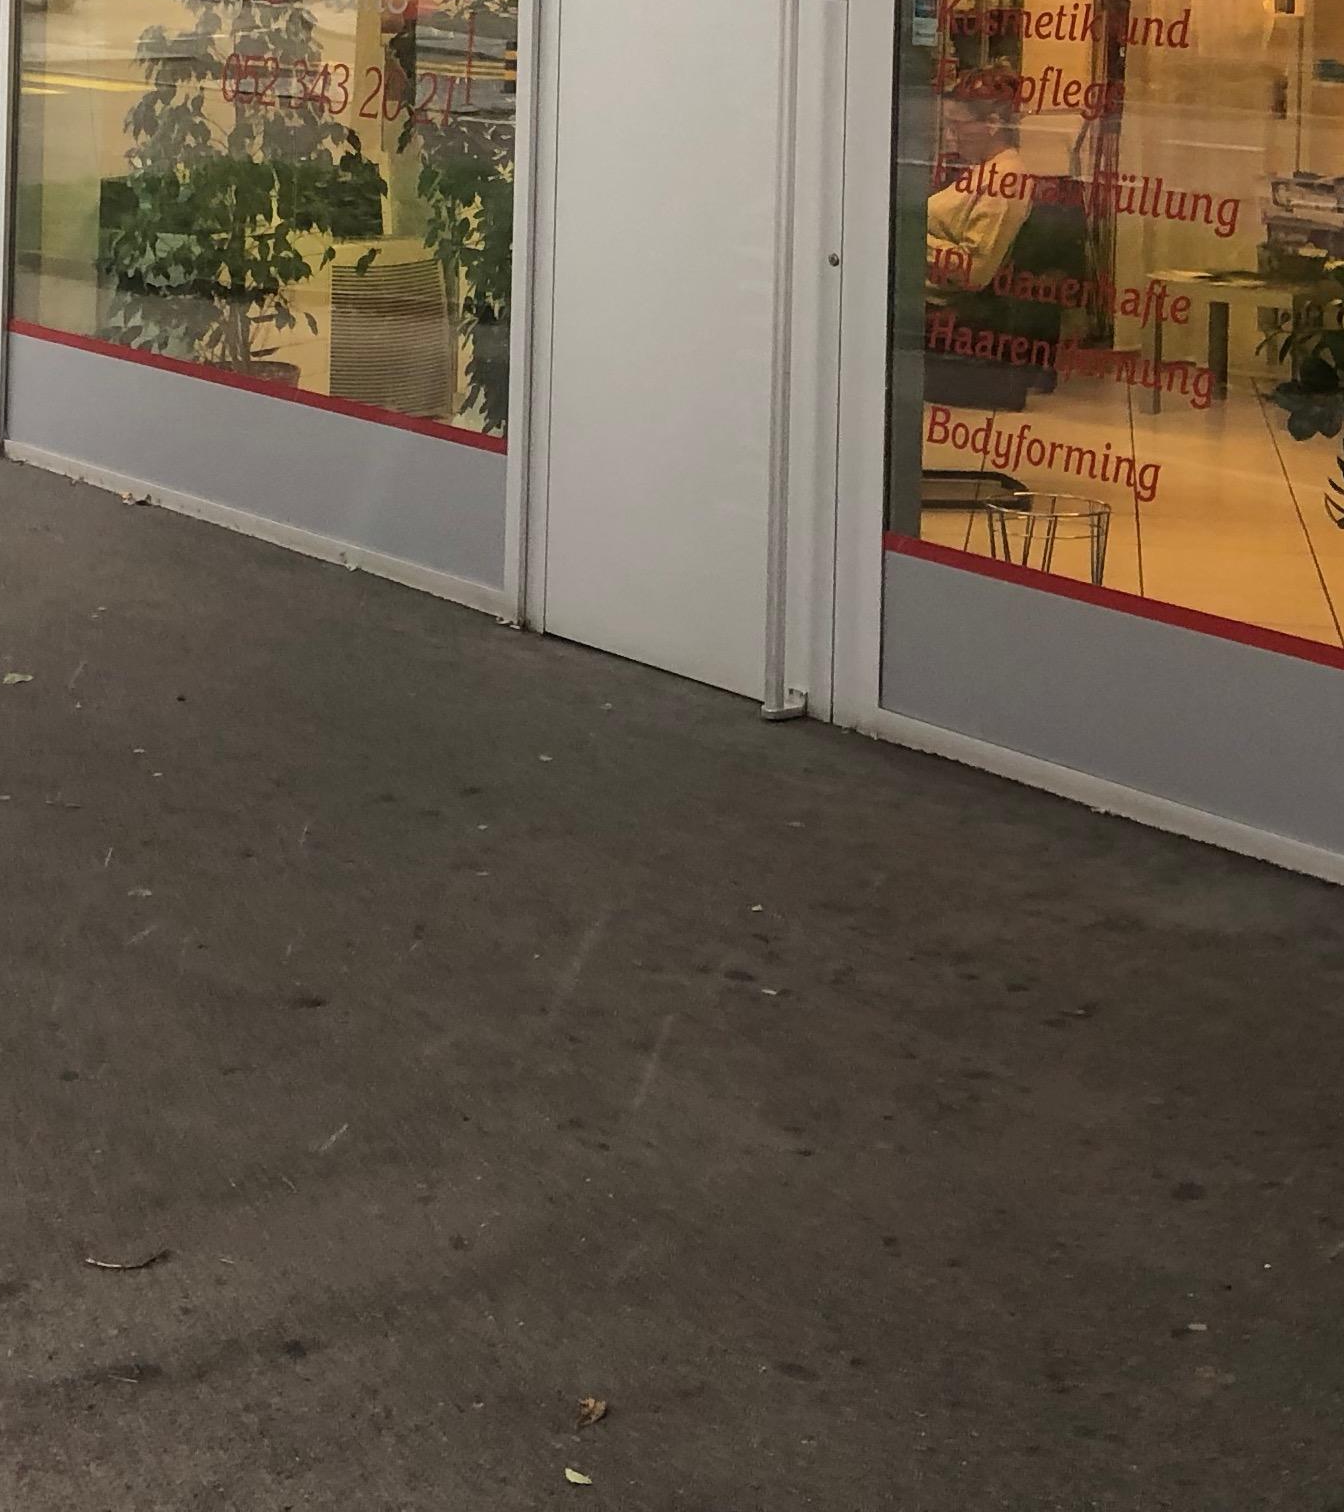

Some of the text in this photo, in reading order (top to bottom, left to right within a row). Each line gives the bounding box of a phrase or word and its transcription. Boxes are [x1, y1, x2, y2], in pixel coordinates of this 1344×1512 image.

[1123, 8, 1190, 49] und
[222, 52, 280, 107] 052
[359, 65, 406, 122] 20
[926, 405, 1161, 502] Bodyforming
